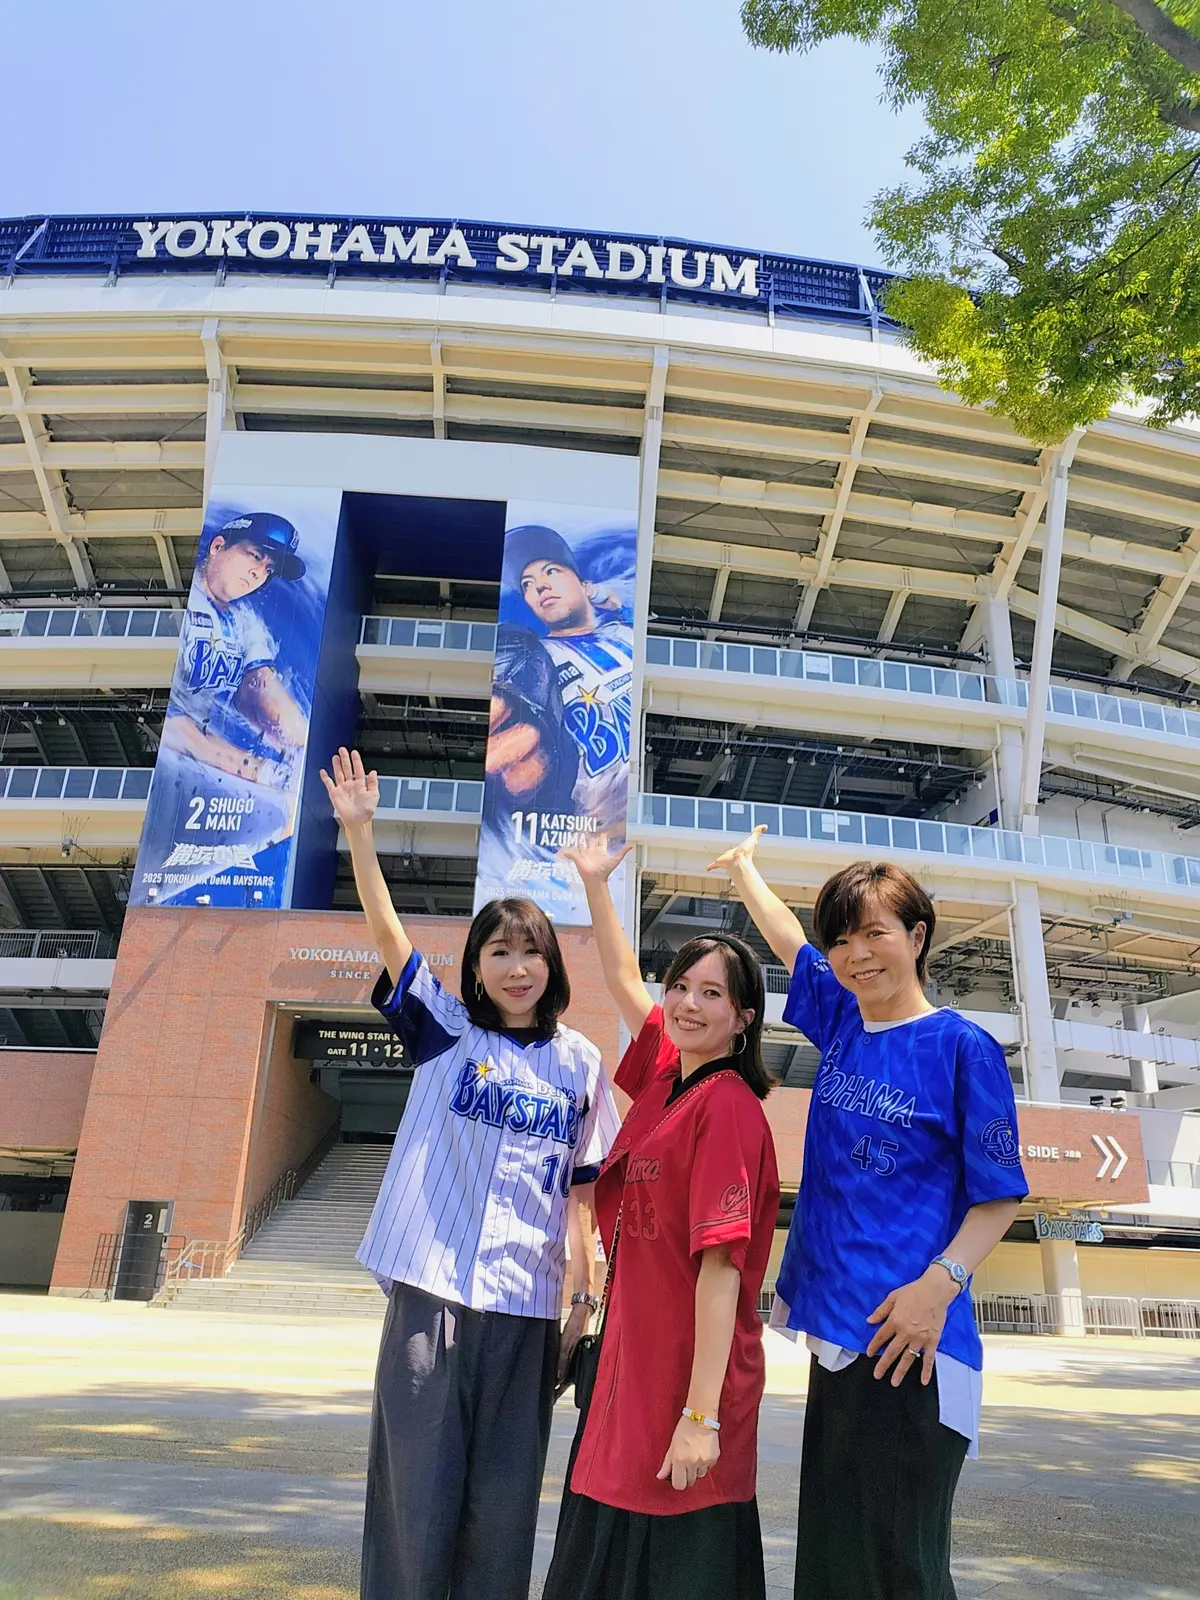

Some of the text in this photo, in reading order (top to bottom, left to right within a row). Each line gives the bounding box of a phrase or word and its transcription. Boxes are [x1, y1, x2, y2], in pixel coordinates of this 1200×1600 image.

[132, 219, 760, 297] YOKOHAMA STADIUM
[184, 796, 206, 830] 2
[208, 797, 254, 815] SHUGO
[205, 814, 242, 831] MAKI
[511, 811, 539, 846] 11
[541, 813, 597, 833] KATSUKI
[540, 831, 588, 848] AZUMA
[142, 873, 275, 887] 2025 YOKOHAMA DeNA BAYSTARS
[289, 947, 381, 963] YOKOHAMA
[330, 970, 371, 980] SINCE
[319, 1030, 337, 1039] THE
[339, 1031, 365, 1040] WING
[367, 1032, 391, 1041] STAR
[327, 1048, 347, 1056] GATE
[851, 1134, 899, 1177] 45
[1027, 1144, 1060, 1159] SIDE
[144, 1213, 154, 1225] 2
[626, 1200, 661, 1242] 33
[1034, 1211, 1104, 1242] BAYSTARS
